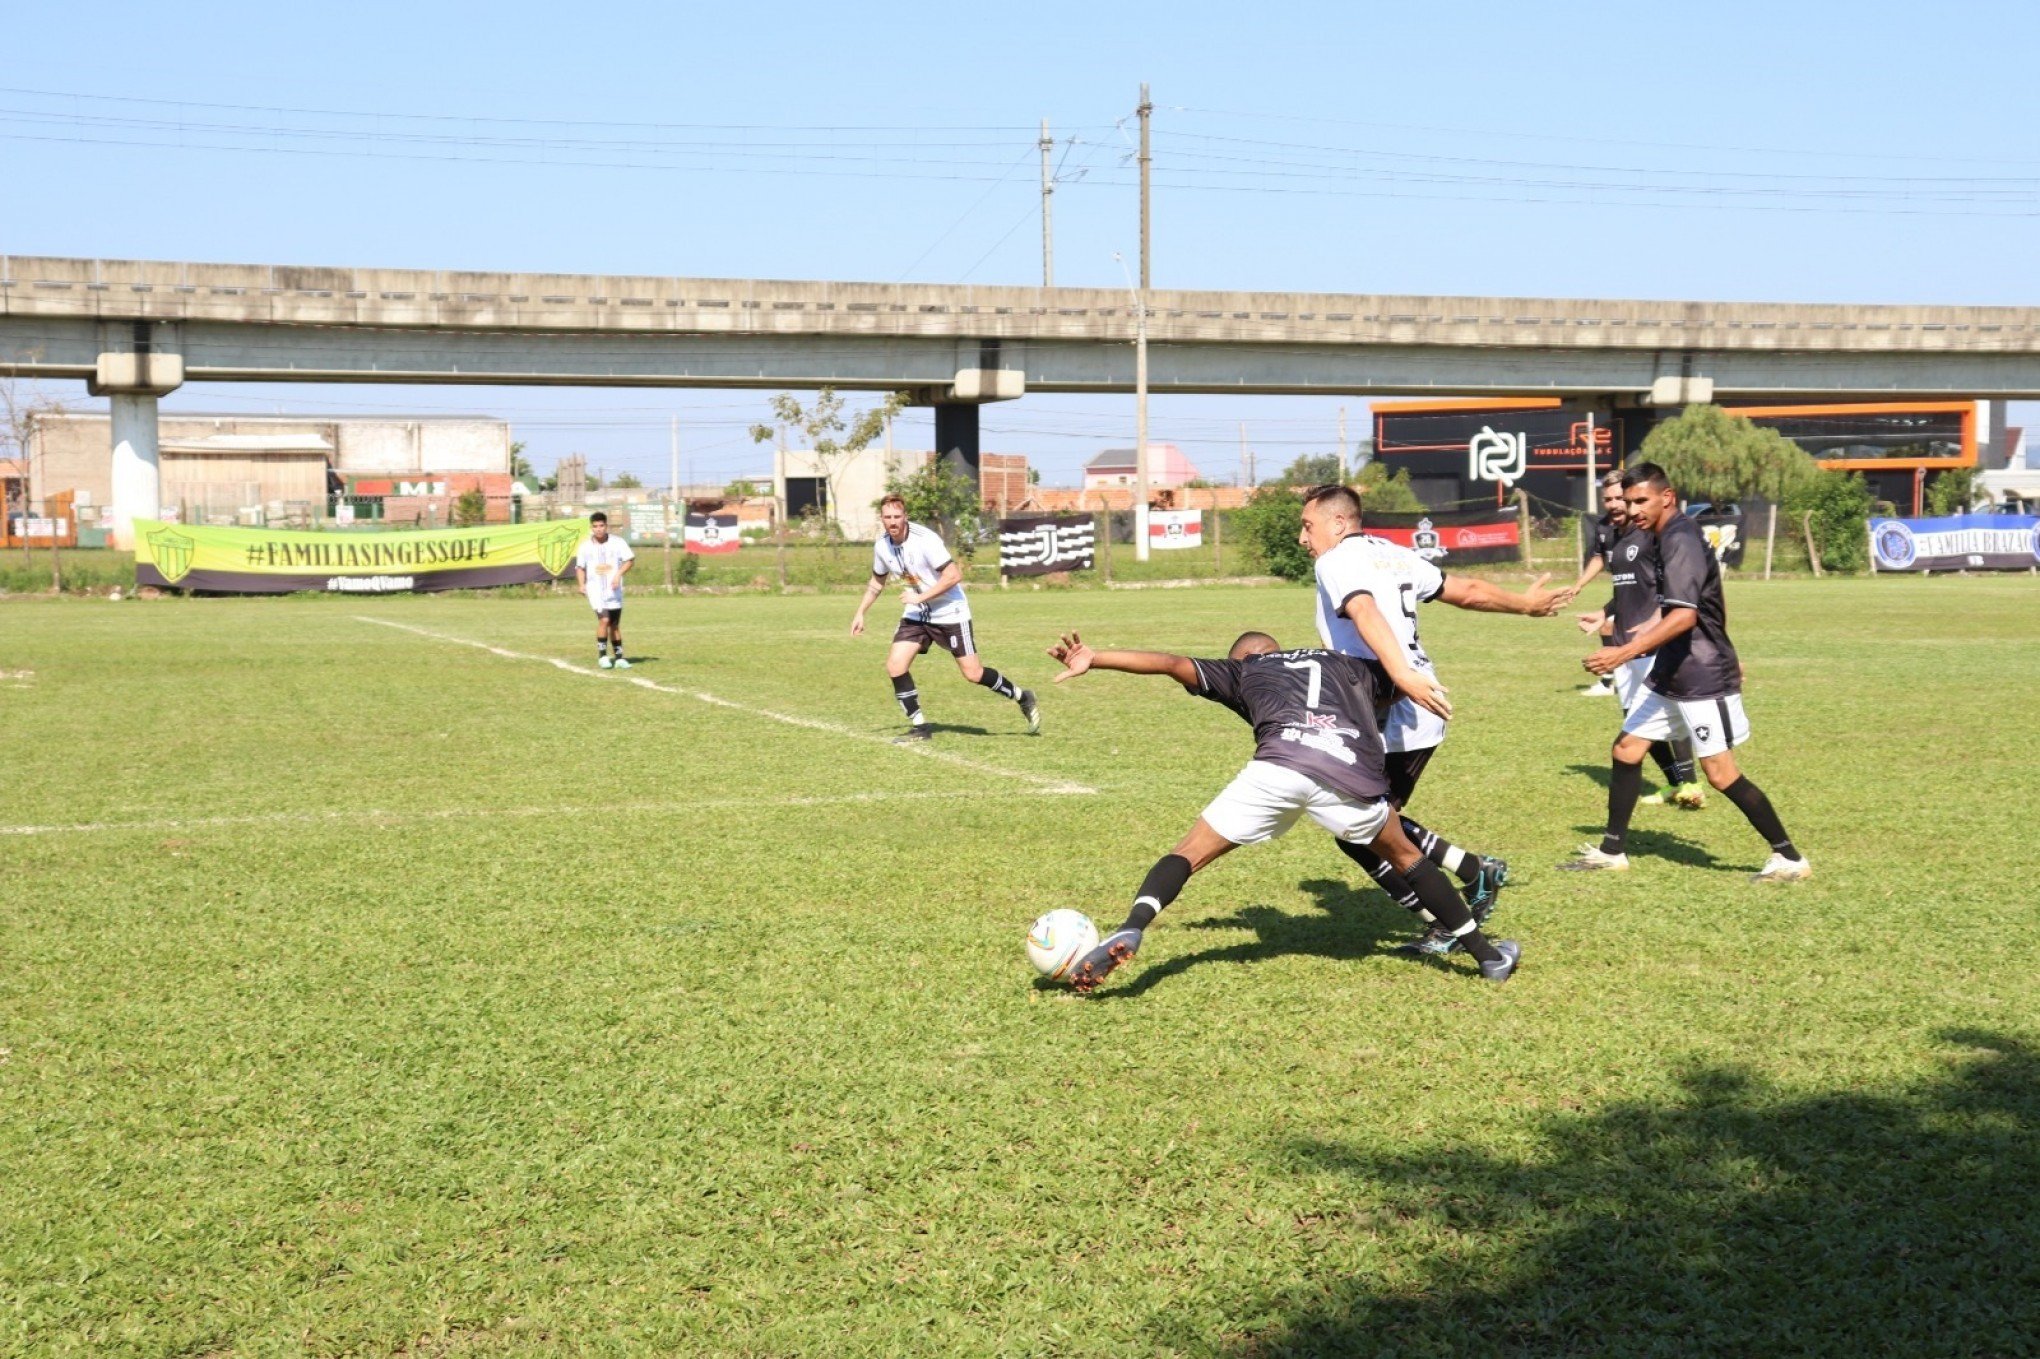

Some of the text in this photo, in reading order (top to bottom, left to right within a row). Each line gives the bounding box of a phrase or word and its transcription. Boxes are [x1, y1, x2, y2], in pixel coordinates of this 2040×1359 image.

[1533, 446, 1594, 456] TUBULAÇÕE
[246, 537, 491, 567] #FAMILIASINGESSOFC
[1284, 659, 1322, 709] 7
